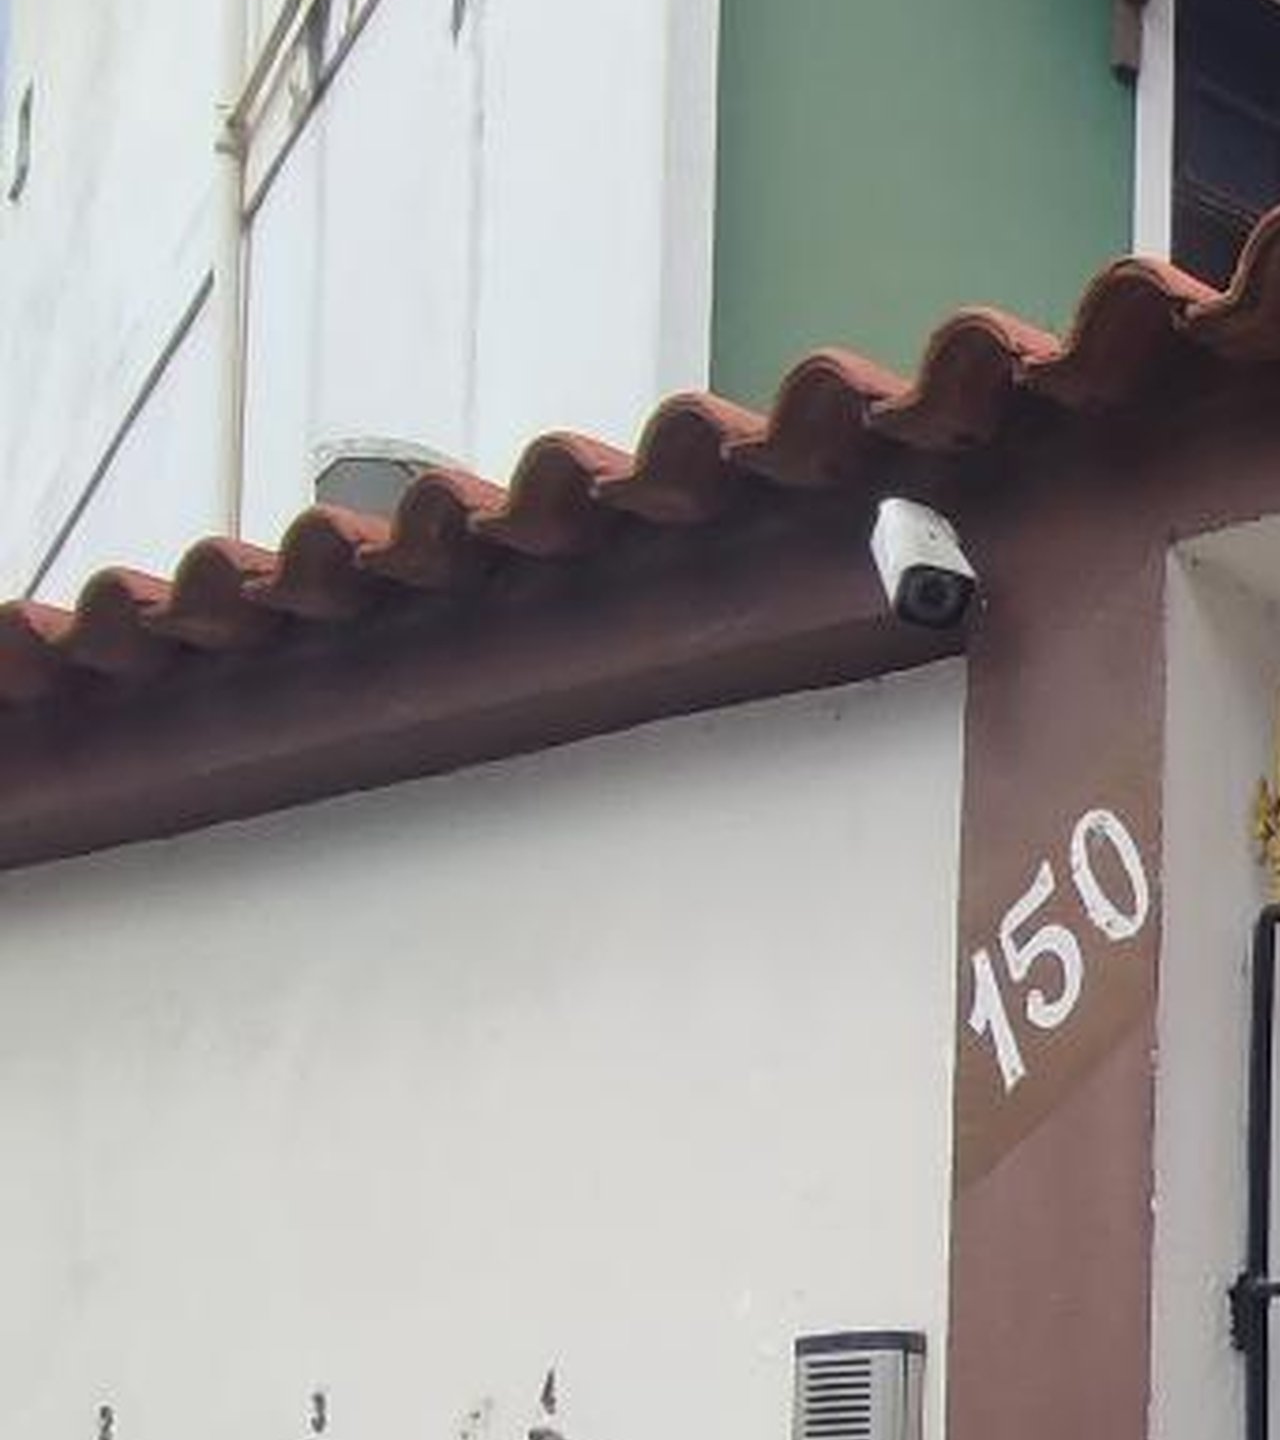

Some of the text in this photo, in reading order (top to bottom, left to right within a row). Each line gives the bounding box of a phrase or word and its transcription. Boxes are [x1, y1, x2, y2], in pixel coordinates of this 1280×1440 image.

[968, 809, 1149, 1094] 150
[311, 1392, 326, 1433] 3
[540, 1368, 557, 1414] 4
